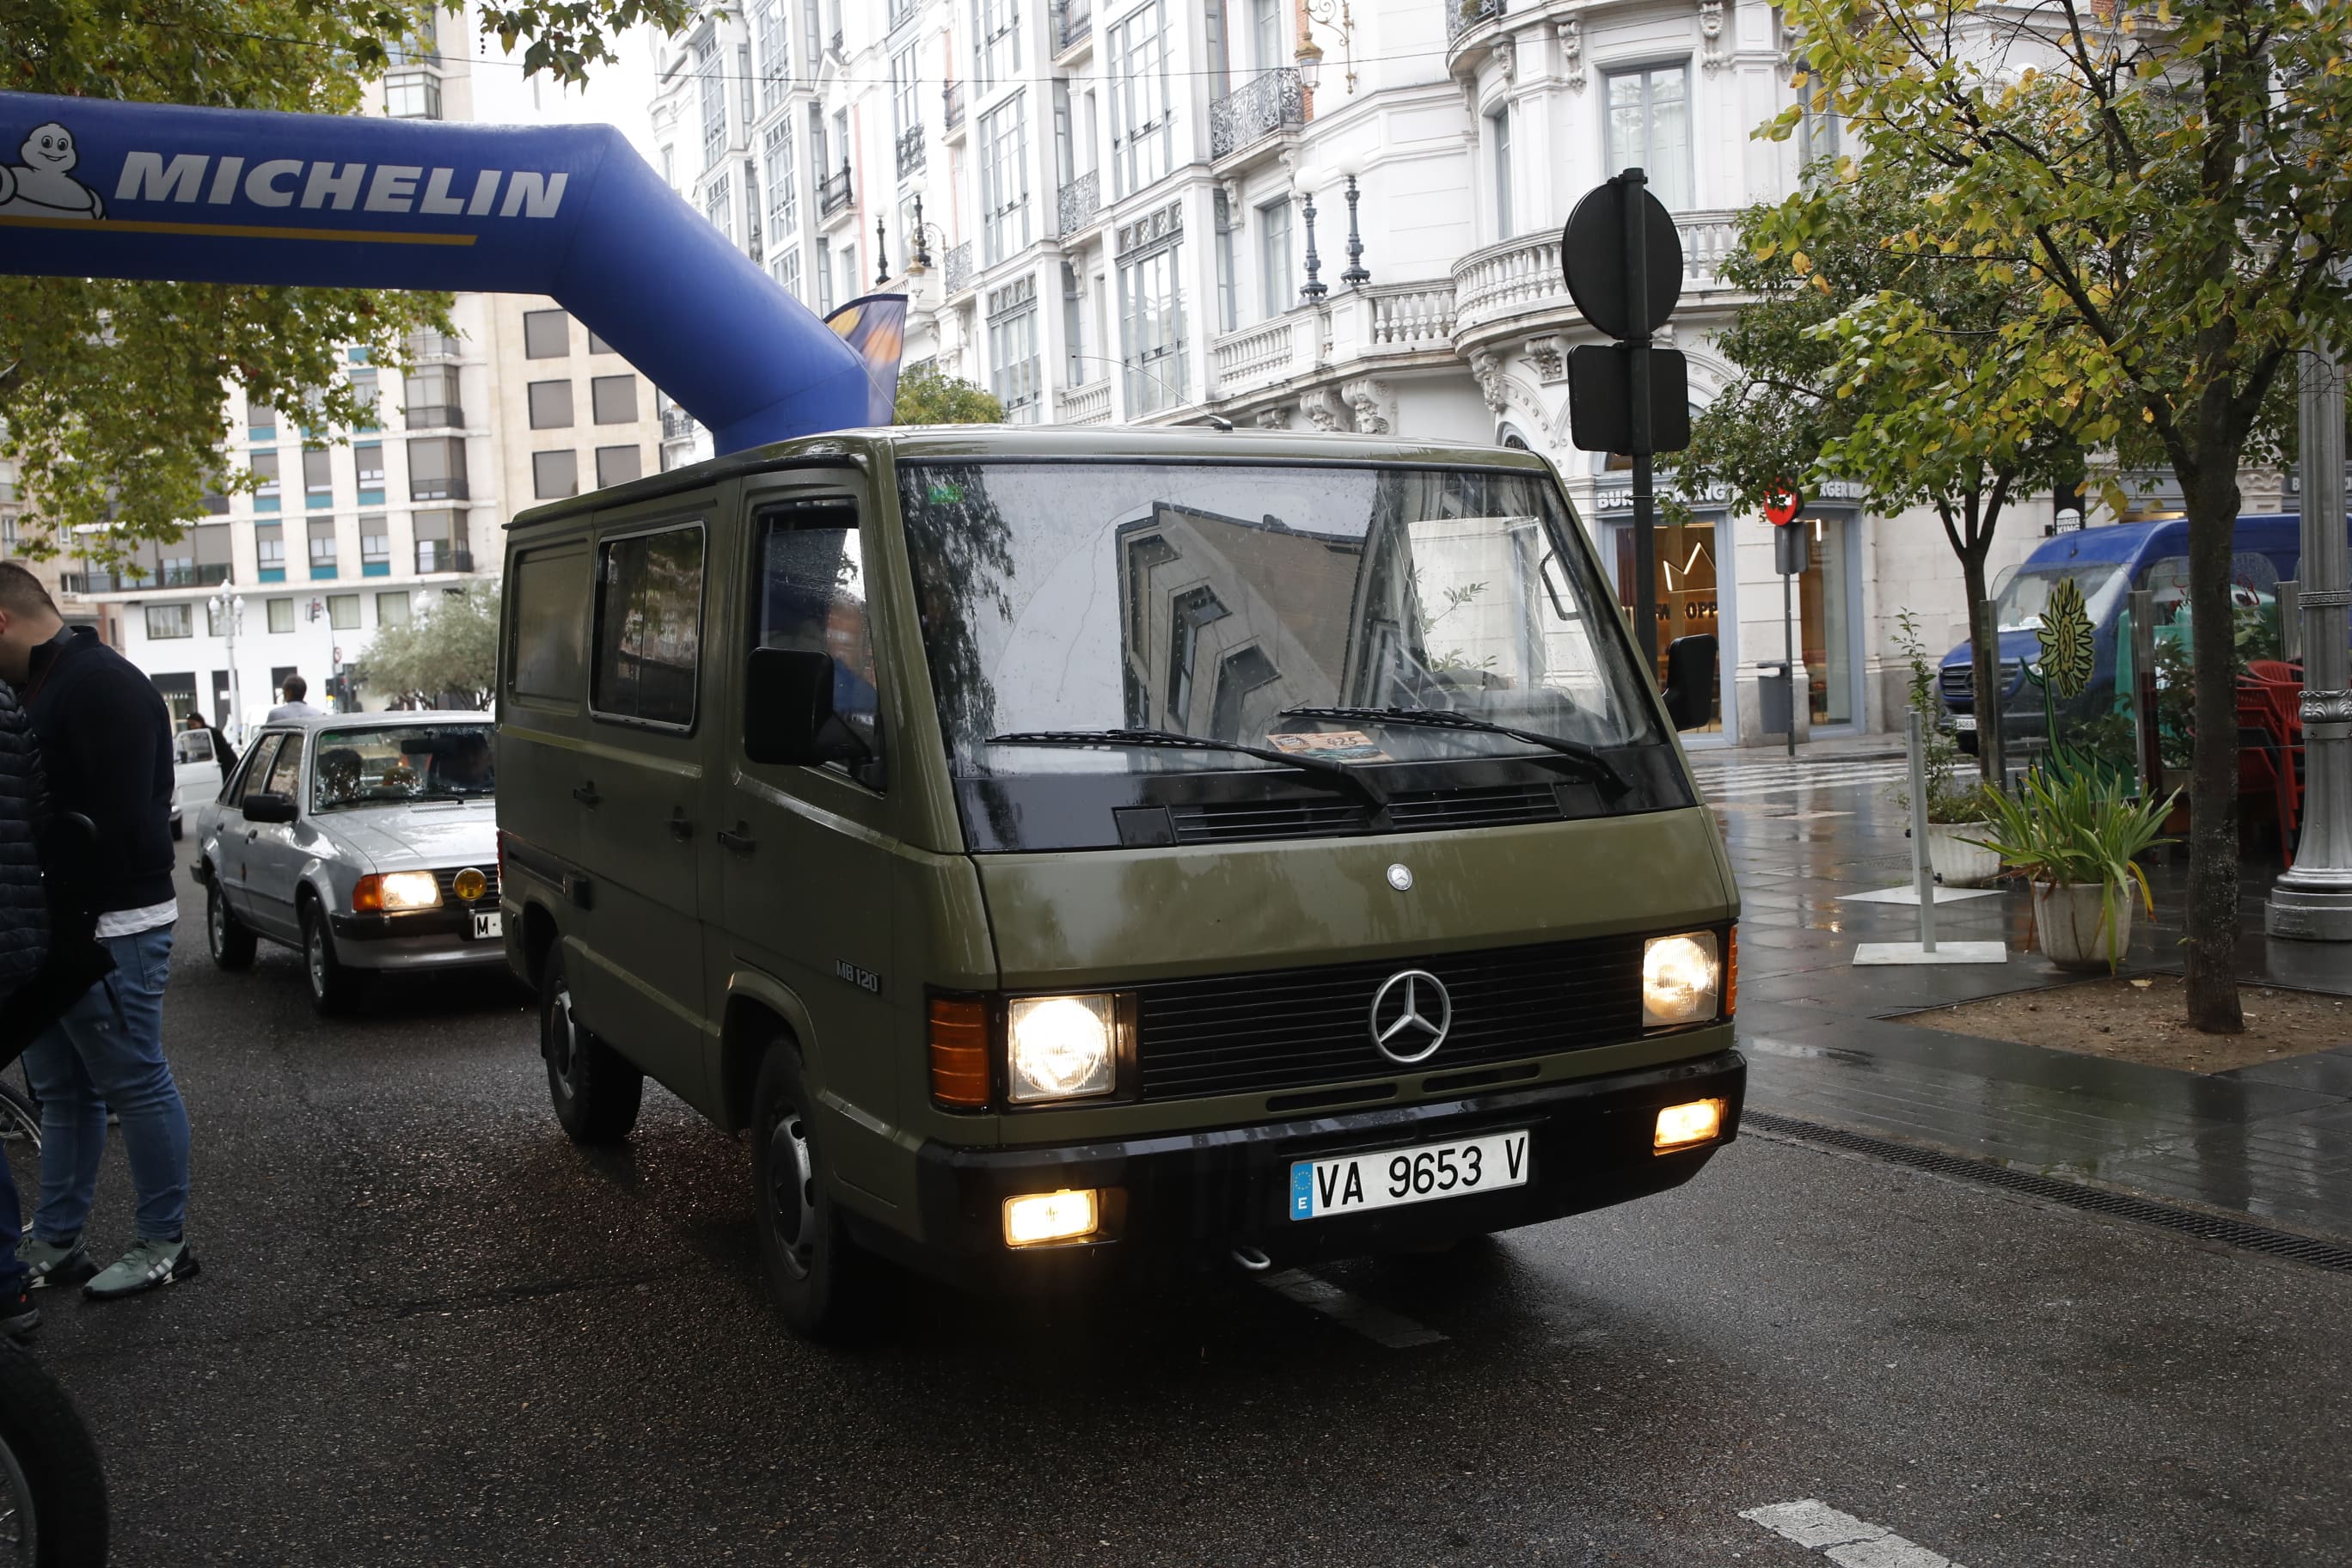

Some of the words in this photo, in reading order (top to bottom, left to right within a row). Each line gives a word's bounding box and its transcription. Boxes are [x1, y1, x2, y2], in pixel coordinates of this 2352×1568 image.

[115, 151, 569, 218] MICHELIN
[836, 959, 853, 981] MB
[1317, 1161, 1363, 1208] VA
[1388, 1145, 1482, 1197] 9653
[1505, 1136, 1525, 1179] V
[1298, 1197, 1308, 1210] E
